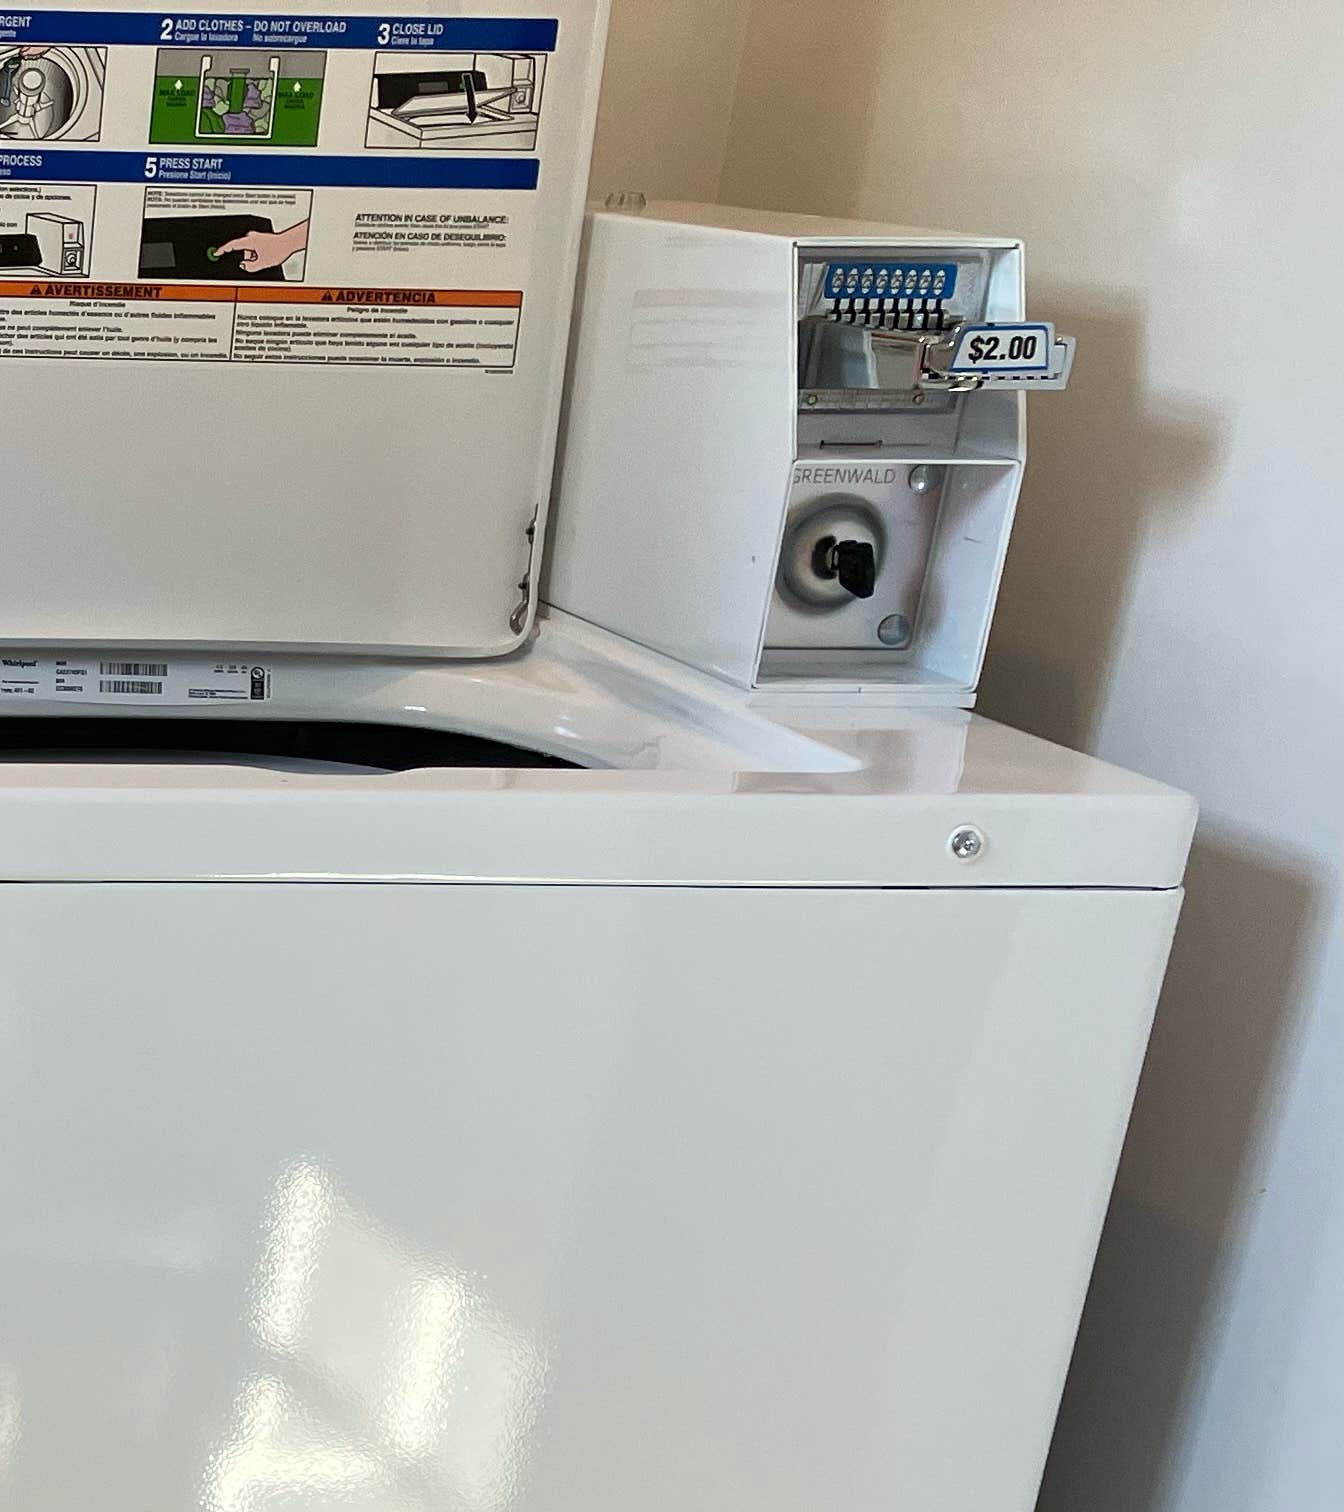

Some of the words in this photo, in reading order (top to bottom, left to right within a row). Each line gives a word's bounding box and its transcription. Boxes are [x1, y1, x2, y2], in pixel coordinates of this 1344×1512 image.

[160, 18, 173, 40] 2
[176, 20, 196, 30] ADD
[199, 21, 243, 31] CLOTHES
[254, 22, 267, 32] DO
[270, 23, 290, 32] NOT
[293, 23, 346, 33] OVERLOAD
[378, 24, 390, 44] 3
[393, 24, 425, 34] CLOSE
[428, 24, 443, 35] LID
[145, 157, 157, 177] 5
[160, 158, 191, 169] PRESS
[193, 158, 223, 169] START
[159, 170, 188, 179] Presione
[190, 170, 206, 179] Start
[355, 214, 402, 222] ATTENTION
[415, 215, 437, 223] CASE
[440, 215, 451, 223] OF
[353, 230, 393, 239] ATENCIÓN
[45, 285, 161, 297] AVERTISSEMENT
[336, 291, 436, 303] ADVERTENCIA
[968, 336, 1037, 363] $2.00
